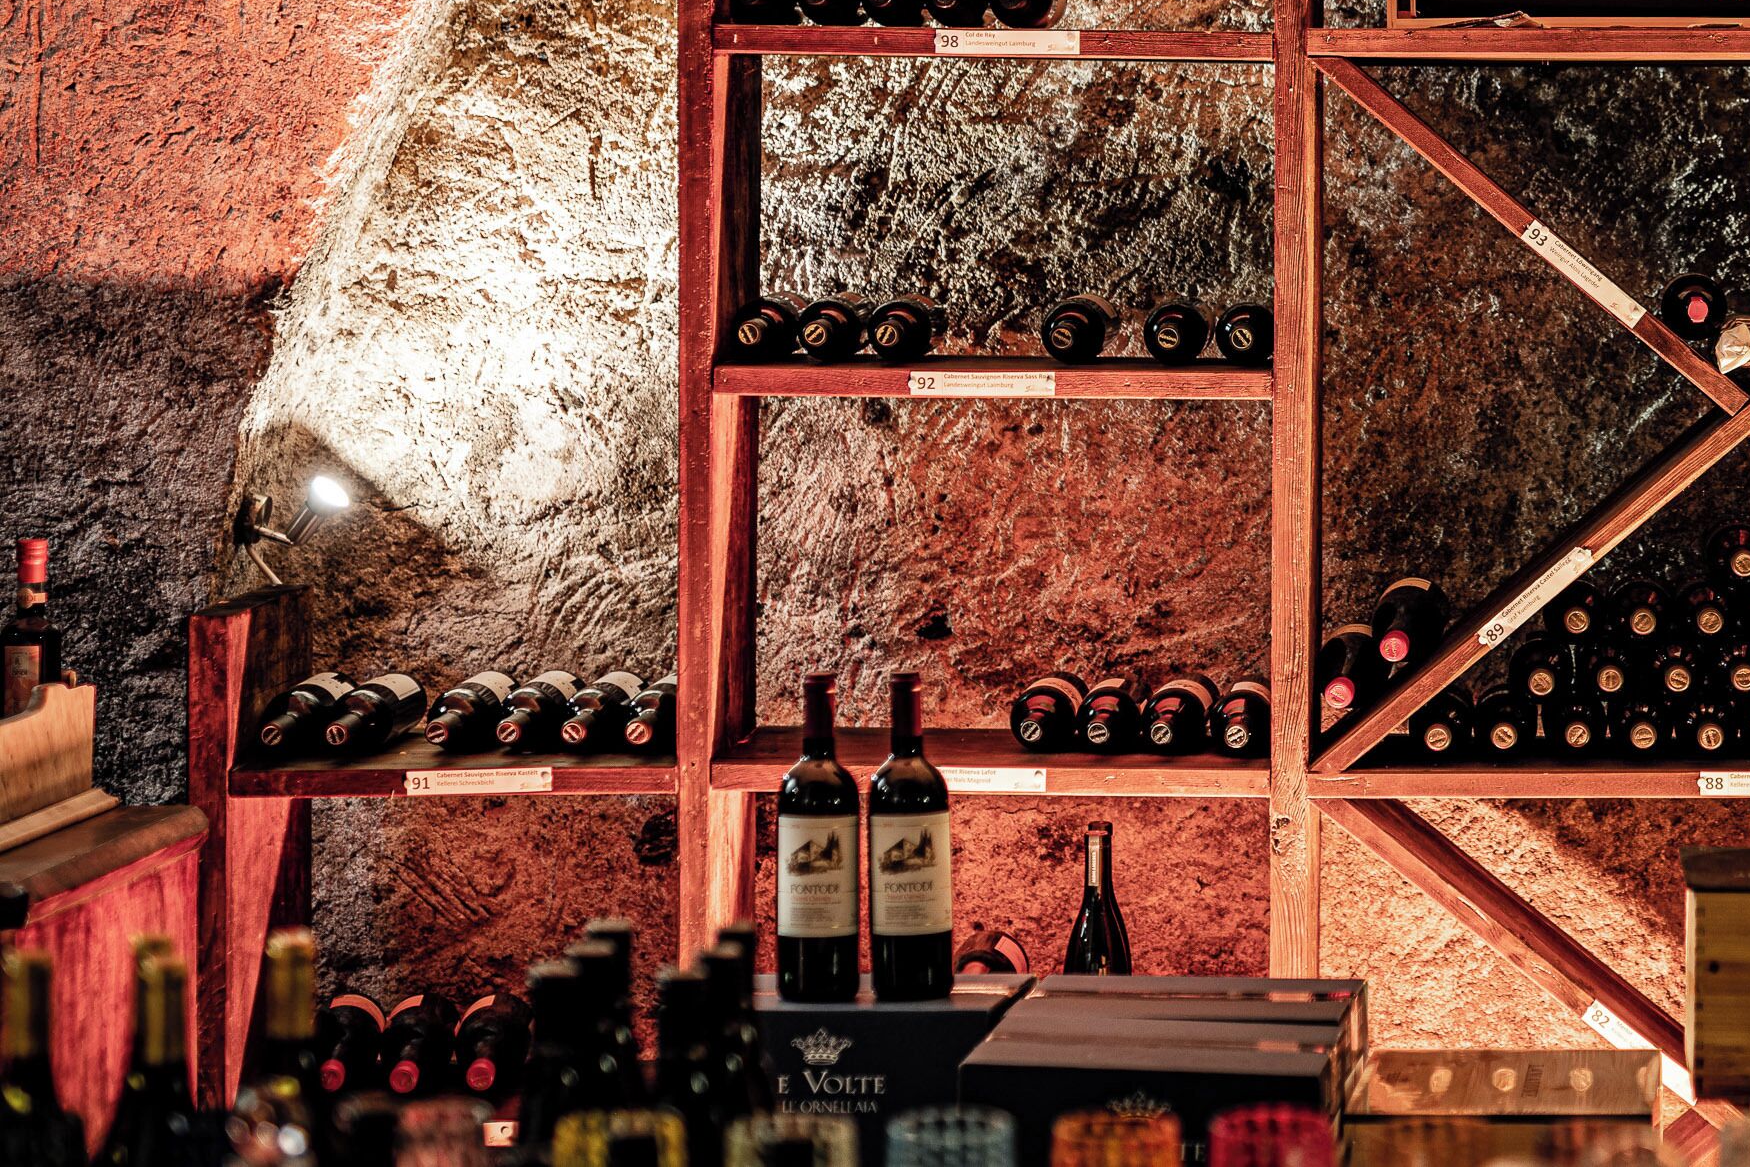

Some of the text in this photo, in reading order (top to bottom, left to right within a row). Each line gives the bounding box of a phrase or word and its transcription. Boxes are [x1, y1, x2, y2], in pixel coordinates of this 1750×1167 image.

[941, 35, 959, 48] 98
[1528, 227, 1548, 246] 93
[1548, 246, 1599, 289] Weingut Alois Lageder
[1554, 240, 1602, 281] Cabernet Löwengang
[917, 377, 935, 390] 92
[1501, 597, 1523, 617] Cabernet
[1522, 583, 1540, 599] Riserva
[1539, 570, 1554, 584] Castel
[1485, 622, 1505, 641] 89
[412, 777, 430, 790] 91
[1705, 778, 1724, 790] 88
[790, 883, 839, 894] FONTODI
[884, 880, 933, 893] FONTODI
[1591, 1009, 1611, 1028] 82
[777, 1069, 886, 1094] E VOLTE
[781, 1100, 879, 1113] LL'ORNELLAIA
